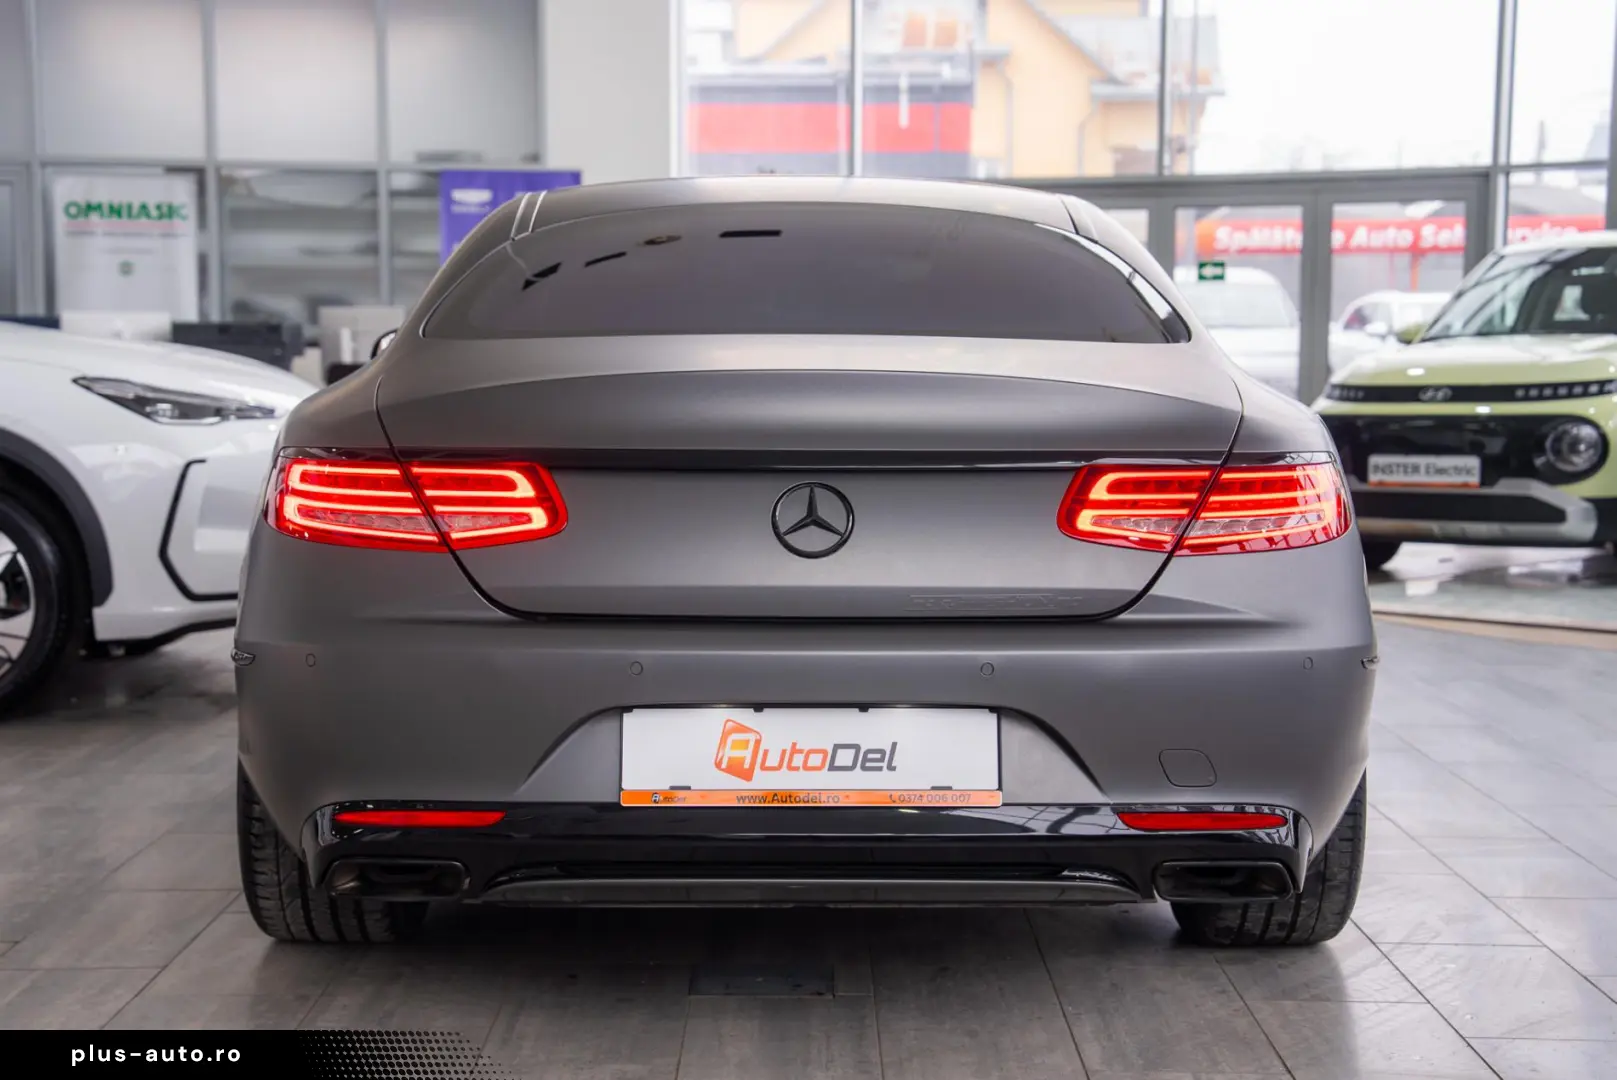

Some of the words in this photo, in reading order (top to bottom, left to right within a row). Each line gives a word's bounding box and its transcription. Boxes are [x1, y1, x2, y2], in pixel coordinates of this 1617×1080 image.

[1350, 225, 1414, 249] Auto
[1371, 462, 1421, 477] INSTER
[1424, 462, 1477, 477] Electric
[720, 733, 898, 772] AutoDel
[736, 792, 840, 805] www.Autodel.ro
[897, 793, 924, 804] 0374
[926, 793, 949, 804] 006
[951, 793, 972, 804] 007
